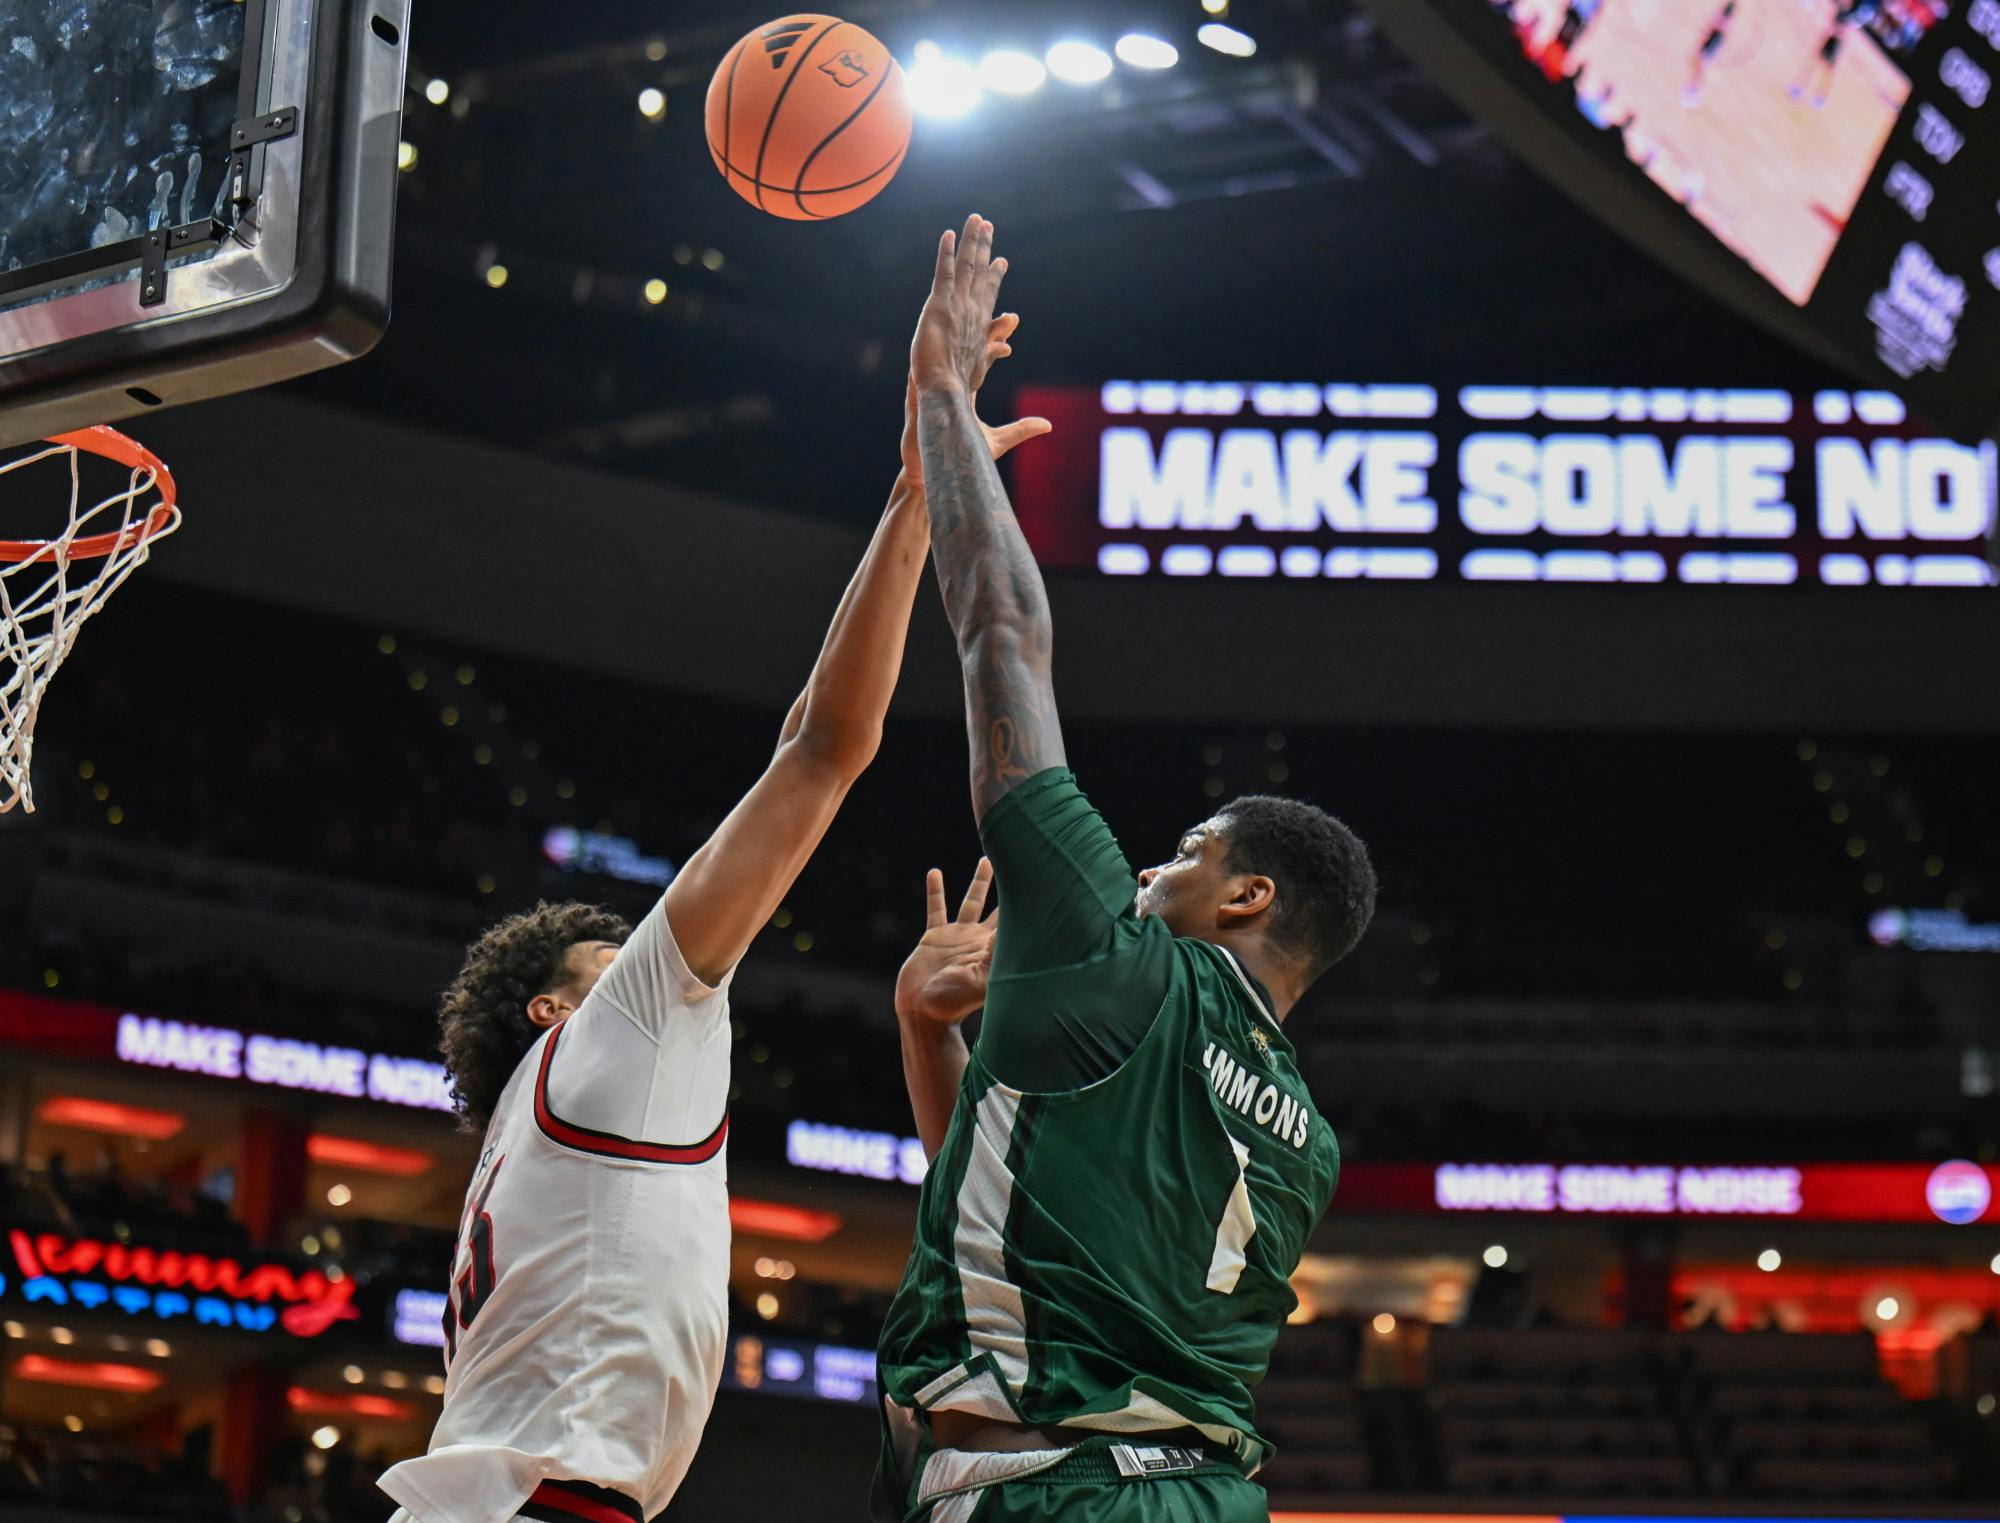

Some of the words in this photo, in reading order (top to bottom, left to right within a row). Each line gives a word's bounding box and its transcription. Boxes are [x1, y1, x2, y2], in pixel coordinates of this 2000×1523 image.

[1100, 427, 1437, 532] MAKE
[1459, 432, 1796, 538] SOME
[117, 1013, 244, 1078] MAKE
[246, 1034, 367, 1098] SOME
[1435, 1163, 1556, 1210] MAKE
[1557, 1164, 1676, 1212] SOME
[1676, 1166, 1802, 1214] NOISE
